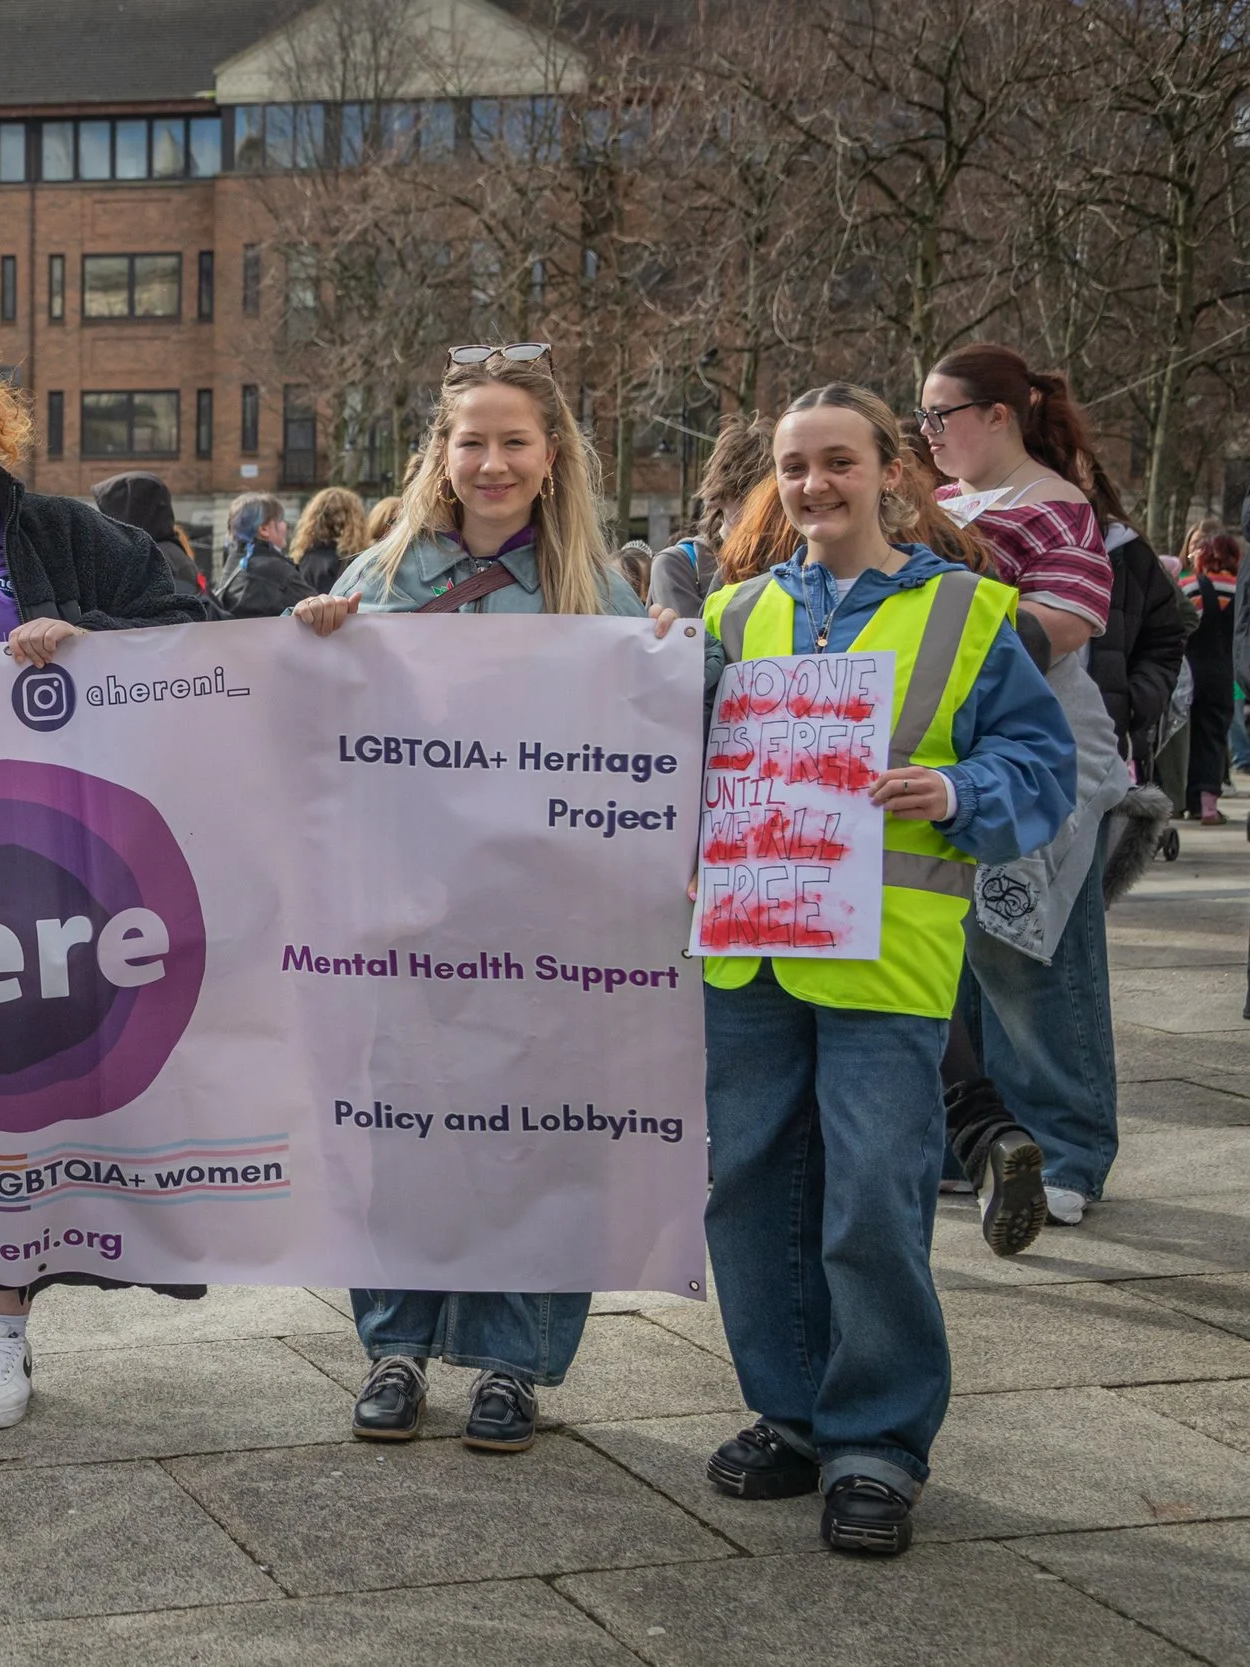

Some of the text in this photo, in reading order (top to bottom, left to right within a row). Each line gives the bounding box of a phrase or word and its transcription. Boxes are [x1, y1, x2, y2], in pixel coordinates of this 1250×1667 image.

[86, 666, 250, 707] @hereni_
[338, 735, 678, 783] LGBTQIA+ Heritage
[707, 720, 876, 790] IS FREE
[705, 776, 786, 809] UNTIL
[548, 798, 678, 838] Project
[702, 807, 844, 861] WE ALL
[700, 864, 837, 948] FREE
[281, 945, 679, 993] Mental Health Support
[334, 1100, 684, 1143] Policy and Lobbying
[156, 1162, 284, 1190] women
